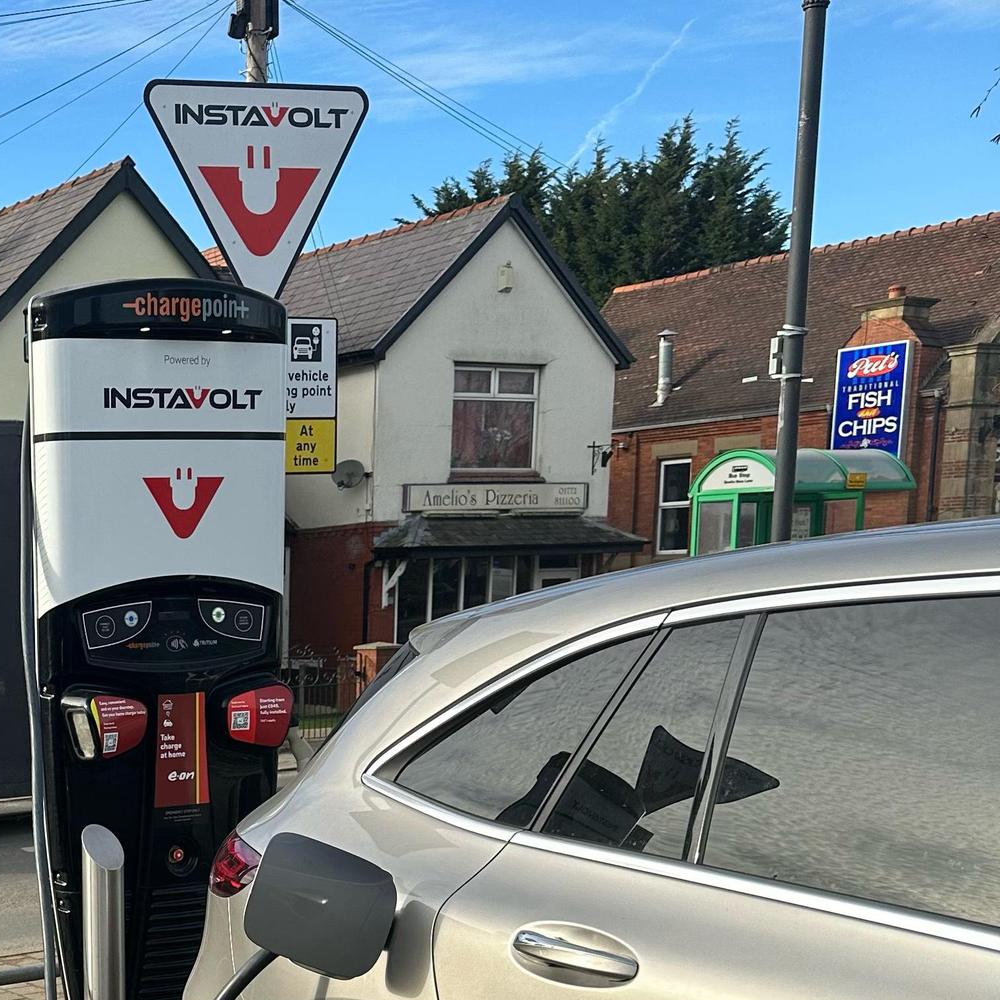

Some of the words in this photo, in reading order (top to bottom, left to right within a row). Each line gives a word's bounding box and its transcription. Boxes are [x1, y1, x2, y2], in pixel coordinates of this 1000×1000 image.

[174, 102, 349, 128] INSTAVOLT
[164, 354, 199, 366] Powered
[201, 355, 211, 367] by
[288, 369, 329, 381] vehicle
[302, 385, 332, 398] point
[842, 380, 900, 393] TRADITIONAL
[103, 386, 263, 410] INSTAVOLT
[848, 389, 892, 410] FISH
[300, 425, 313, 436] At
[838, 416, 898, 437] CHIPS
[296, 442, 317, 453] any
[293, 455, 319, 466] time
[422, 488, 478, 507] Amelio's
[485, 488, 539, 506] Pizzeria
[160, 742, 182, 751] charge
